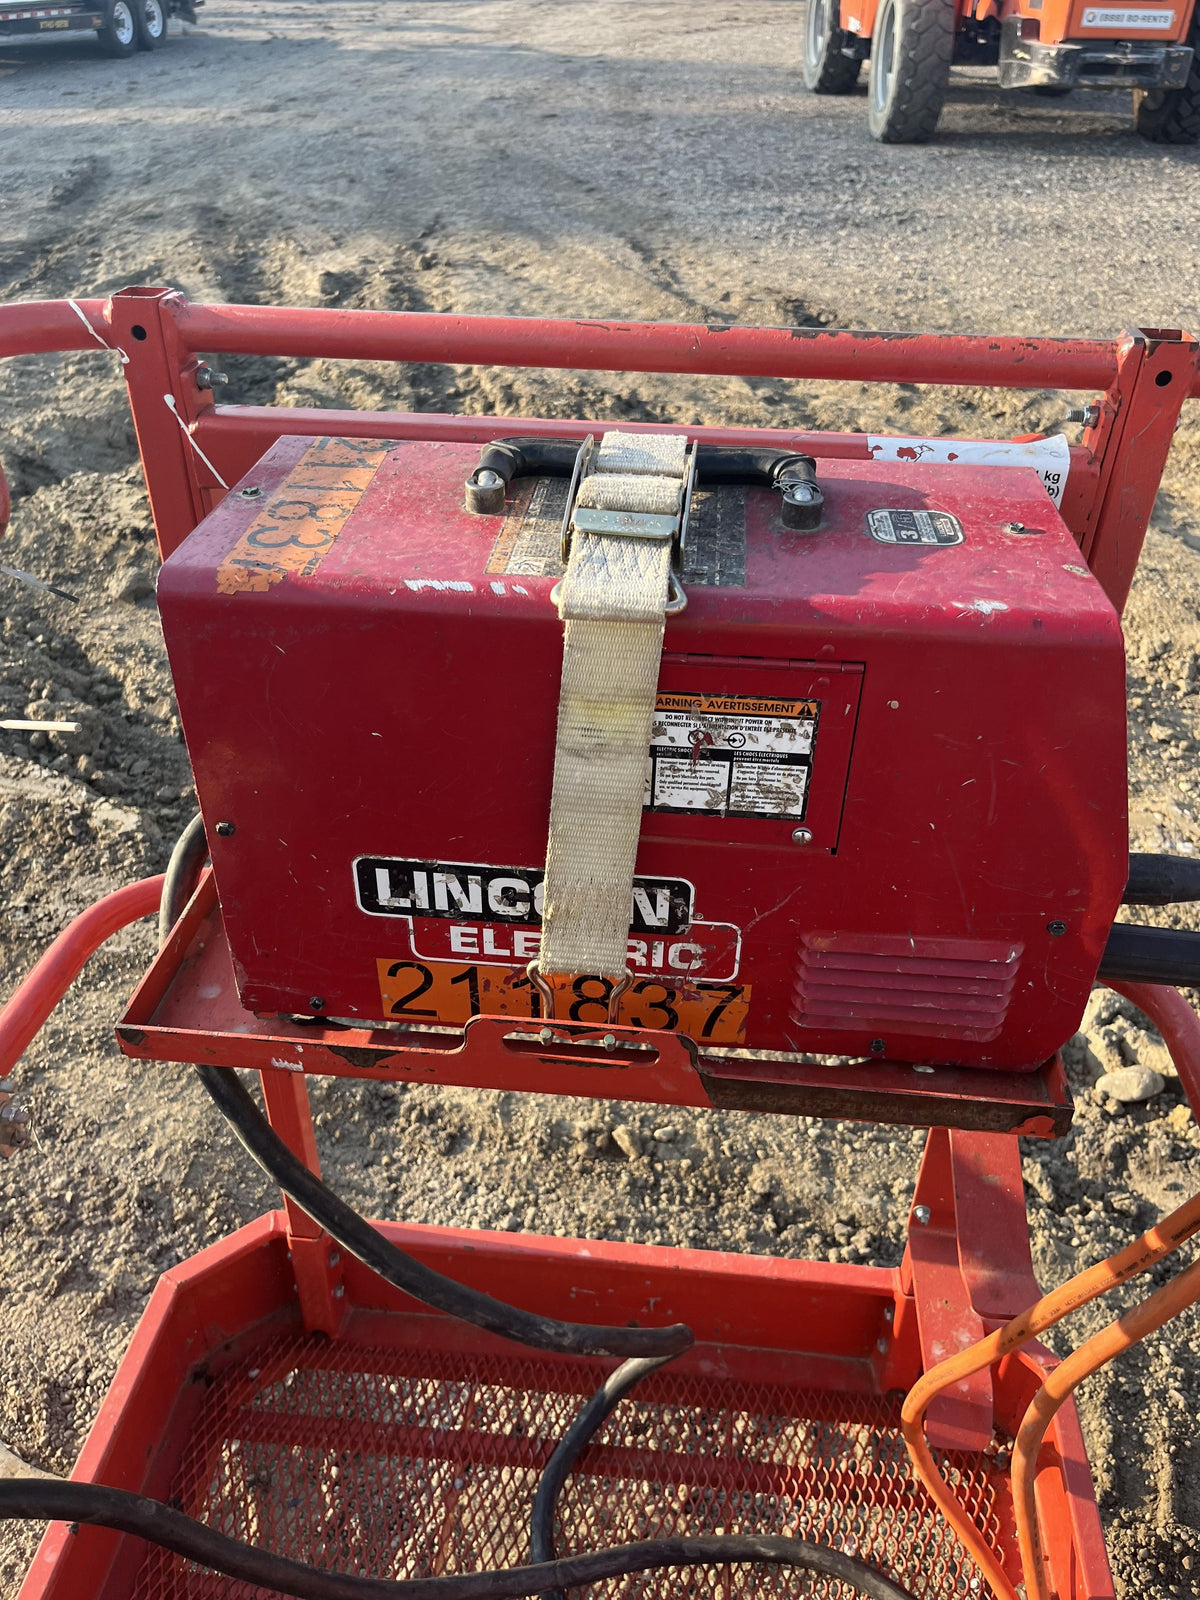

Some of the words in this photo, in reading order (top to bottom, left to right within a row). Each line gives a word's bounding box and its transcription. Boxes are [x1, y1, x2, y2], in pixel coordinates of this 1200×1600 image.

[1043, 470, 1061, 484] kg
[655, 696, 703, 708] ARNING
[707, 699, 796, 713] AVERTISSEMENT
[658, 720, 692, 728] RECONNECTER
[375, 867, 671, 927] LINCN
[449, 924, 704, 970] ELERIC
[387, 960, 745, 1038] 211837
